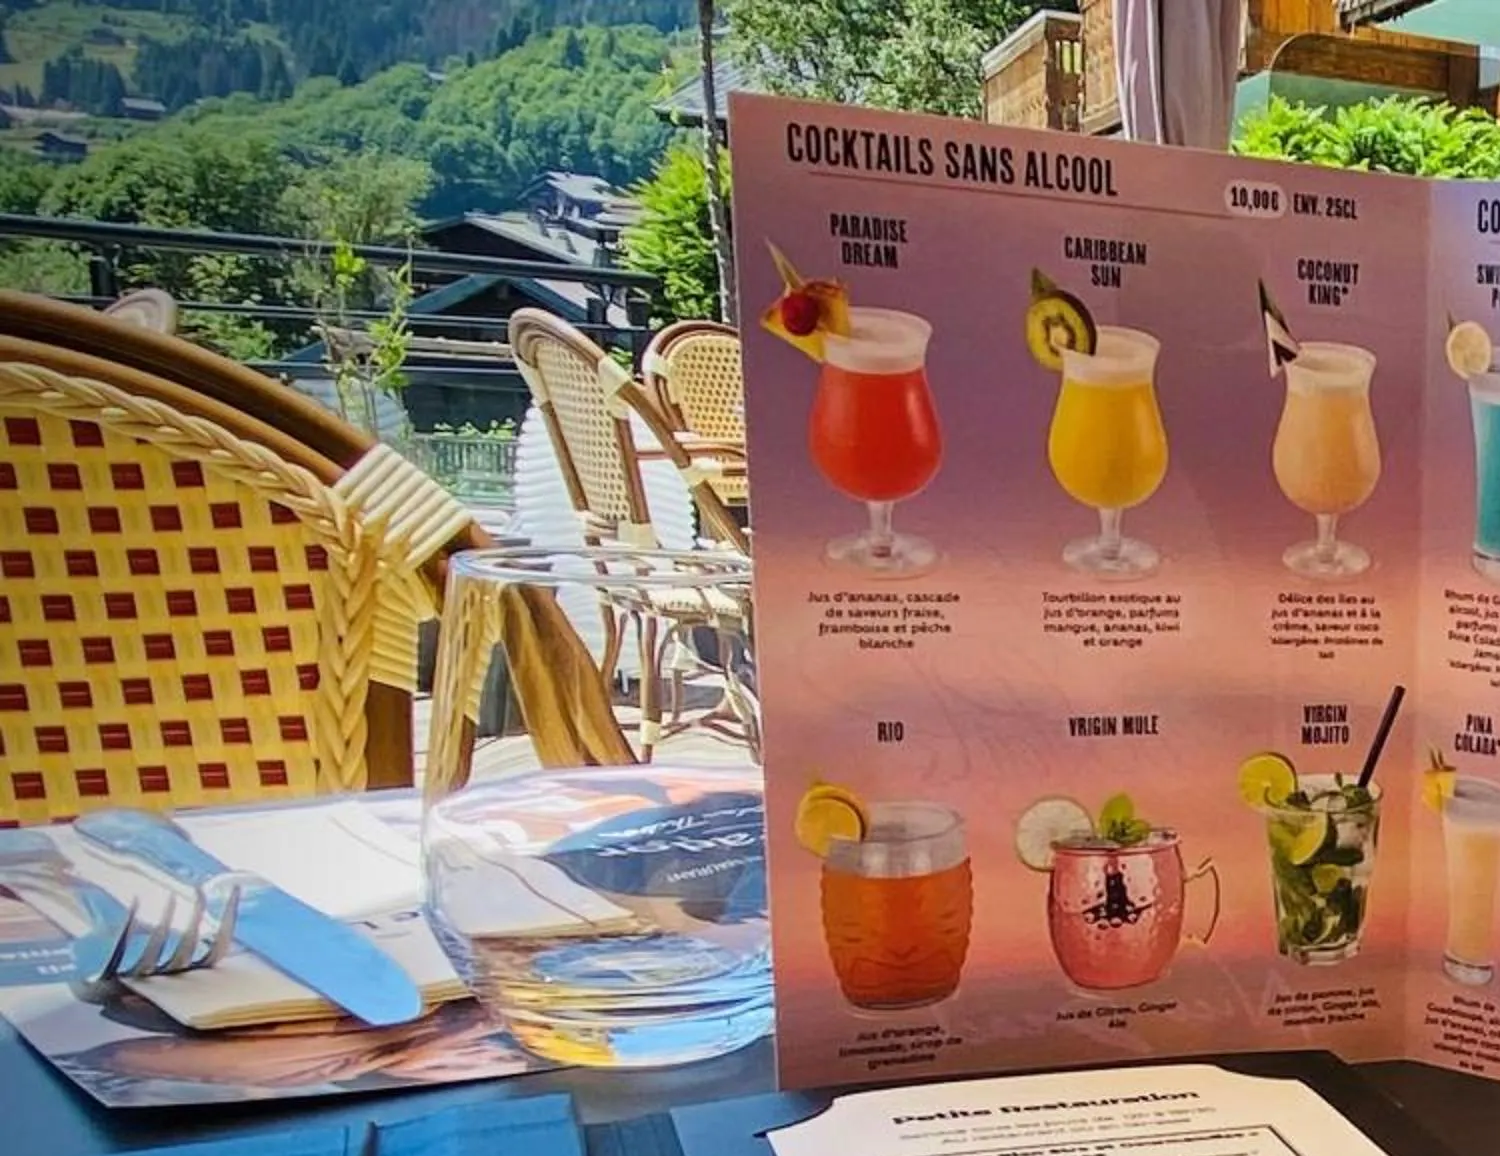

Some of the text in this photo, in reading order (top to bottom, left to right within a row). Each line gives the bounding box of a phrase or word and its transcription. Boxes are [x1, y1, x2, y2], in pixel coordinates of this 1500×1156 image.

[786, 122, 1119, 197] COCKTAILS SANS ALCOOL
[830, 213, 908, 244] PARADISE
[842, 241, 898, 269] DREAM
[1064, 236, 1147, 266] CARIBBEAN
[1091, 264, 1122, 289] SUN
[1297, 258, 1359, 285] COCONUT
[906, 591, 960, 603] cascade
[825, 606, 945, 621] de saveurs fraise,
[818, 621, 952, 637] framboise et pêche
[858, 637, 915, 650] blanche
[1121, 714, 1160, 736] MULE
[1303, 704, 1348, 725] VIRGIN
[1465, 713, 1494, 736] PINA
[877, 721, 905, 743] RIO
[1301, 724, 1350, 746] MOJITO
[892, 1104, 992, 1126] Petite
[999, 1091, 1201, 1117] Restauration
